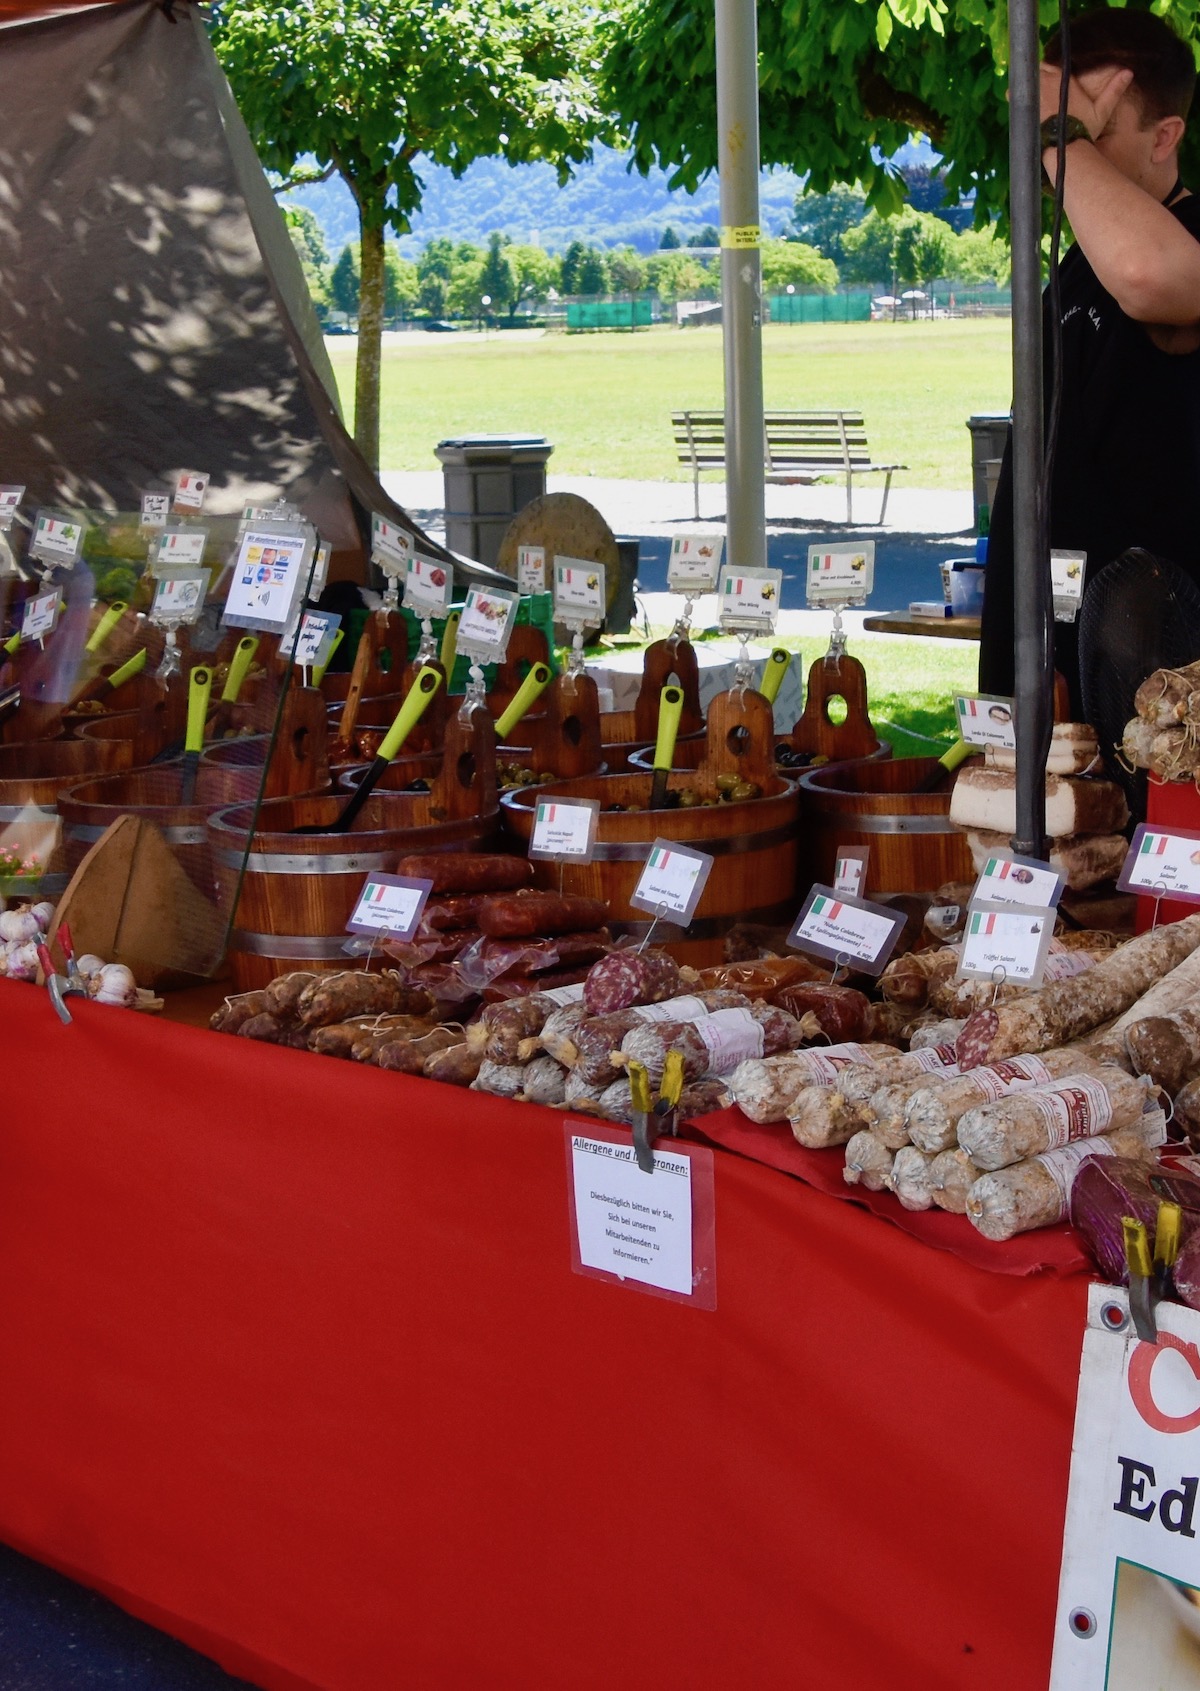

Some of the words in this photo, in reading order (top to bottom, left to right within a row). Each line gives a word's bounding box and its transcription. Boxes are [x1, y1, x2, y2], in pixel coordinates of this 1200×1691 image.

[1163, 864, 1178, 873] König
[840, 927, 865, 940] Calabrese
[983, 953, 999, 962] Trüffel
[573, 1137, 613, 1156] Allergene
[614, 1148, 630, 1160] und
[633, 1150, 688, 1175] Ieranzen:
[590, 1191, 630, 1208] Diesbezüglich
[631, 1202, 650, 1214] bitten
[651, 1206, 661, 1216] wir
[662, 1210, 674, 1221] Sie,
[608, 1212, 620, 1223] Sich
[621, 1216, 631, 1225] bei
[632, 1220, 656, 1233] unseren
[605, 1228, 651, 1248] Mitarbeitenden
